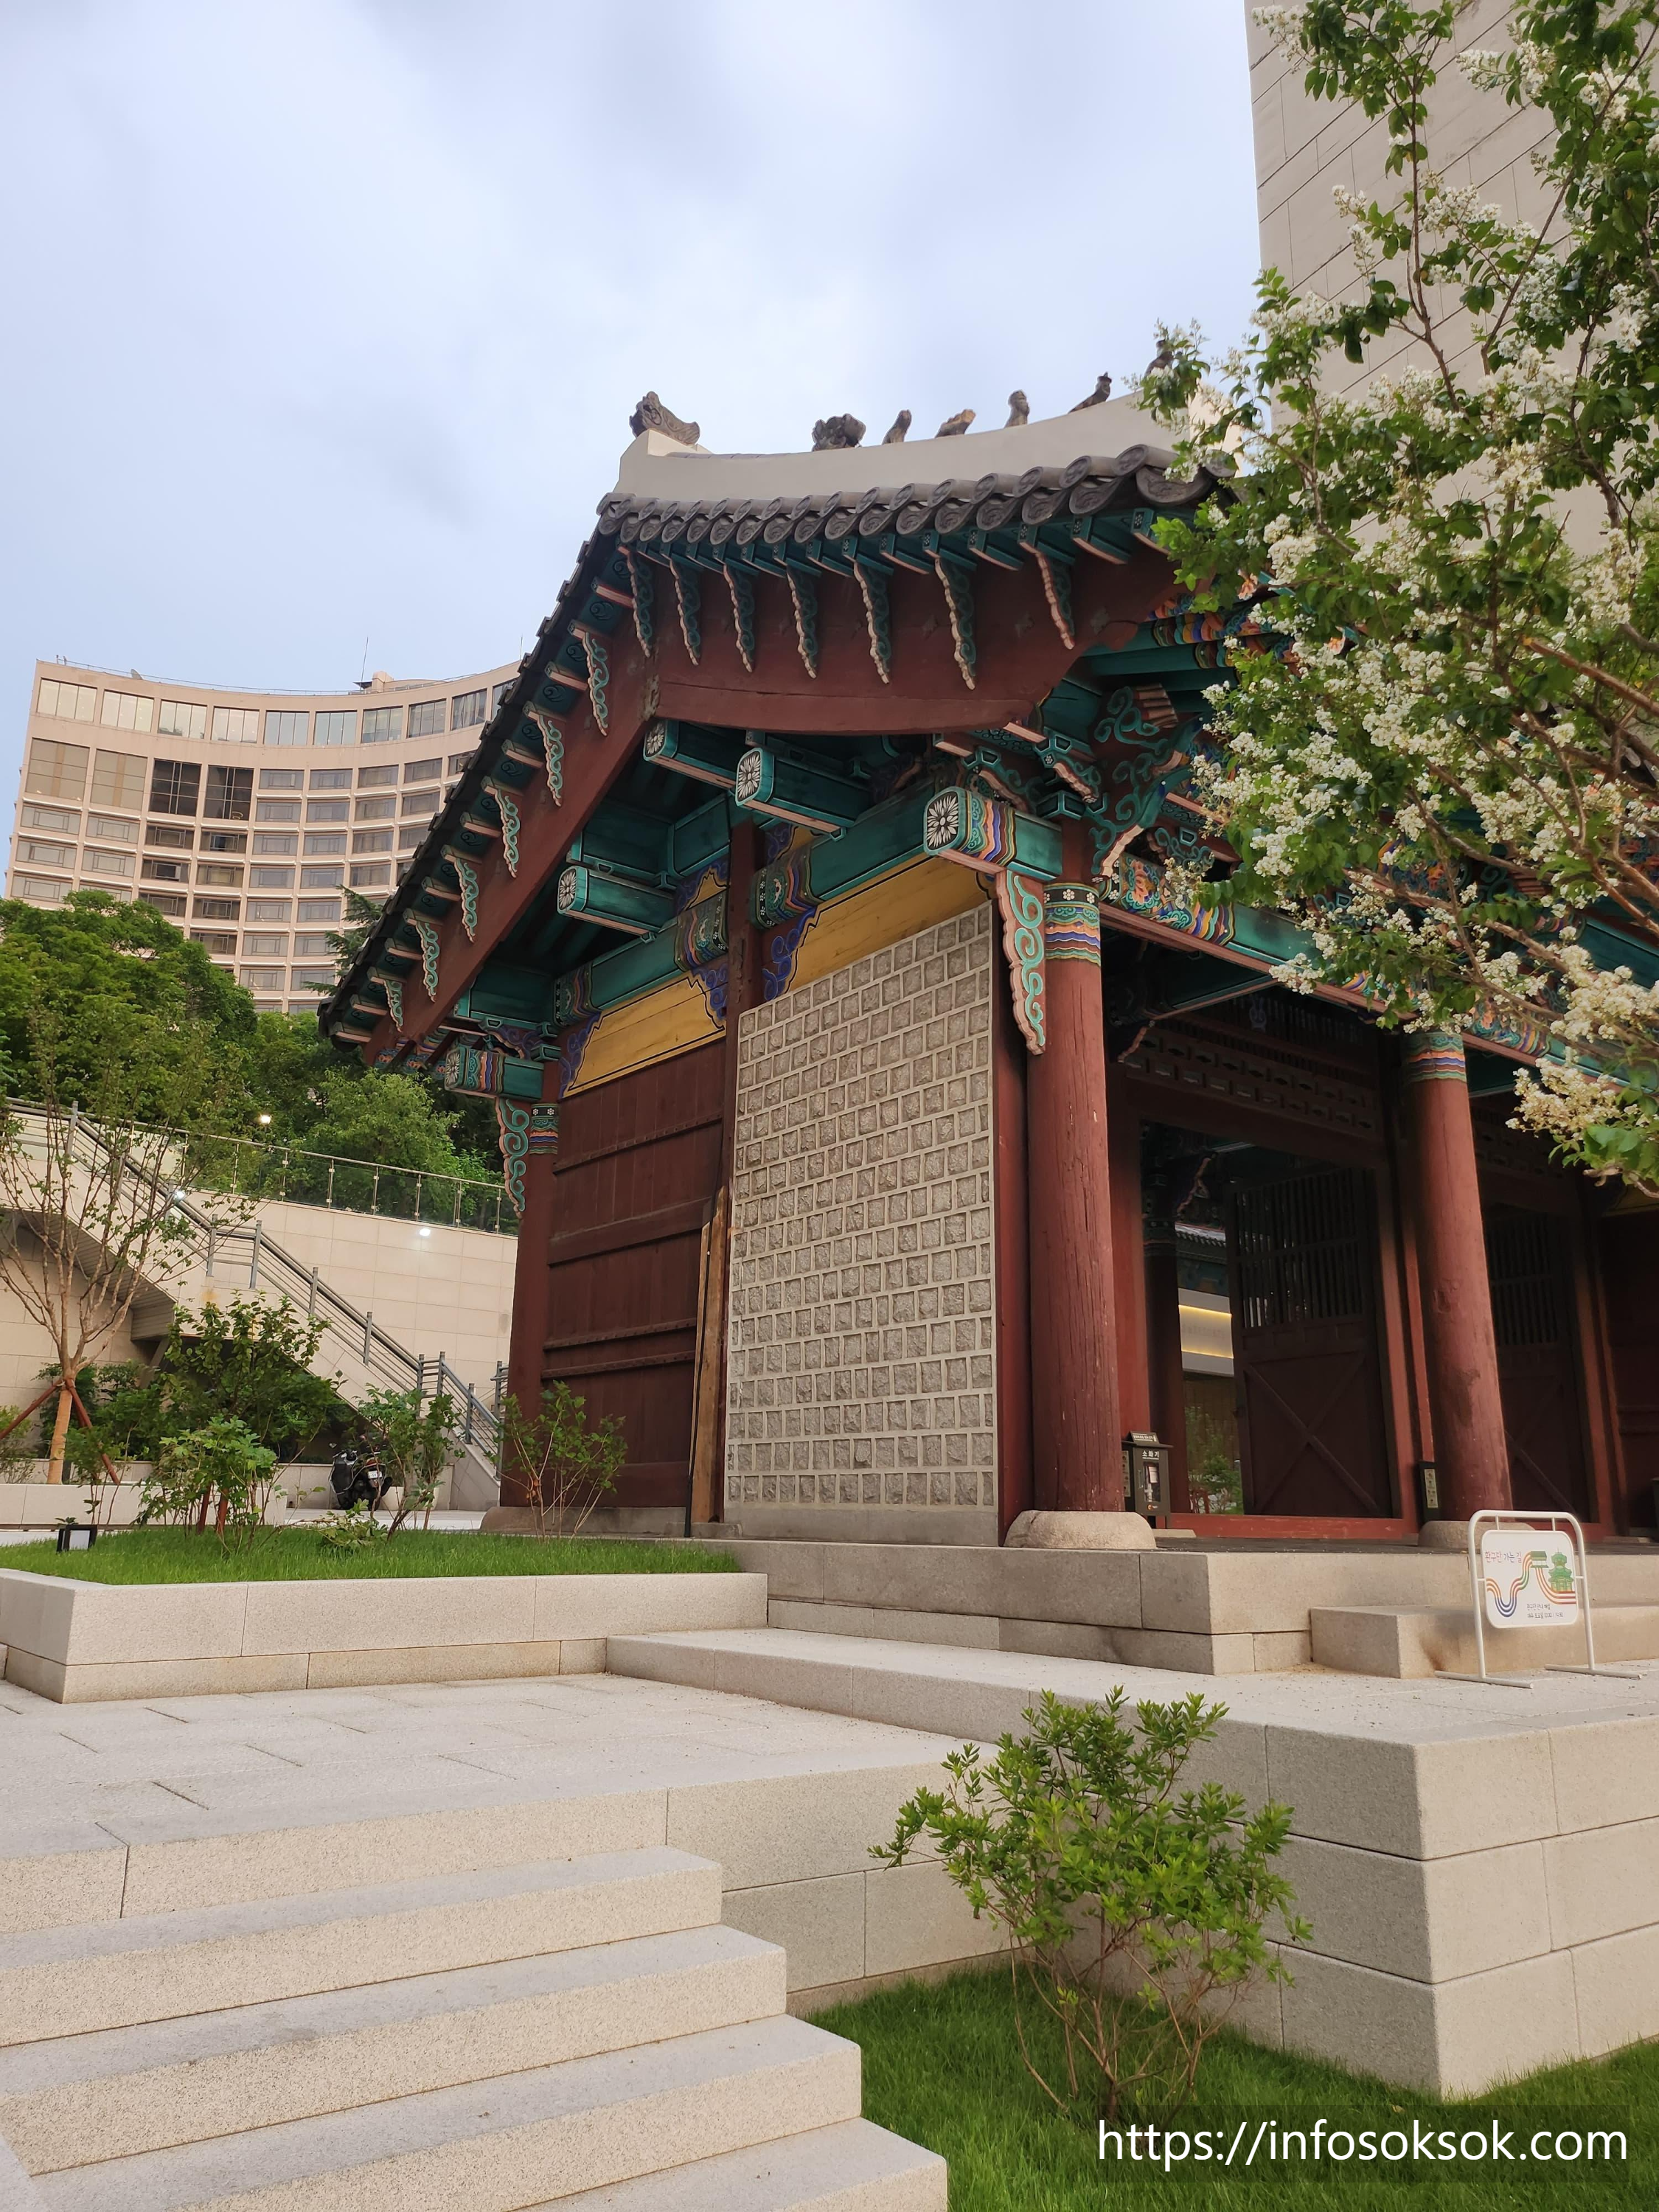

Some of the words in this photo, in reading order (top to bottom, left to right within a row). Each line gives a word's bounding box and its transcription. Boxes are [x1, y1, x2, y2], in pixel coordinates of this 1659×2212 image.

[1142, 1450, 1159, 1458] 소화기
[1485, 1551, 1502, 1563] 환구단
[1503, 1551, 1515, 1563] 가는
[1516, 1551, 1522, 1563] 길
